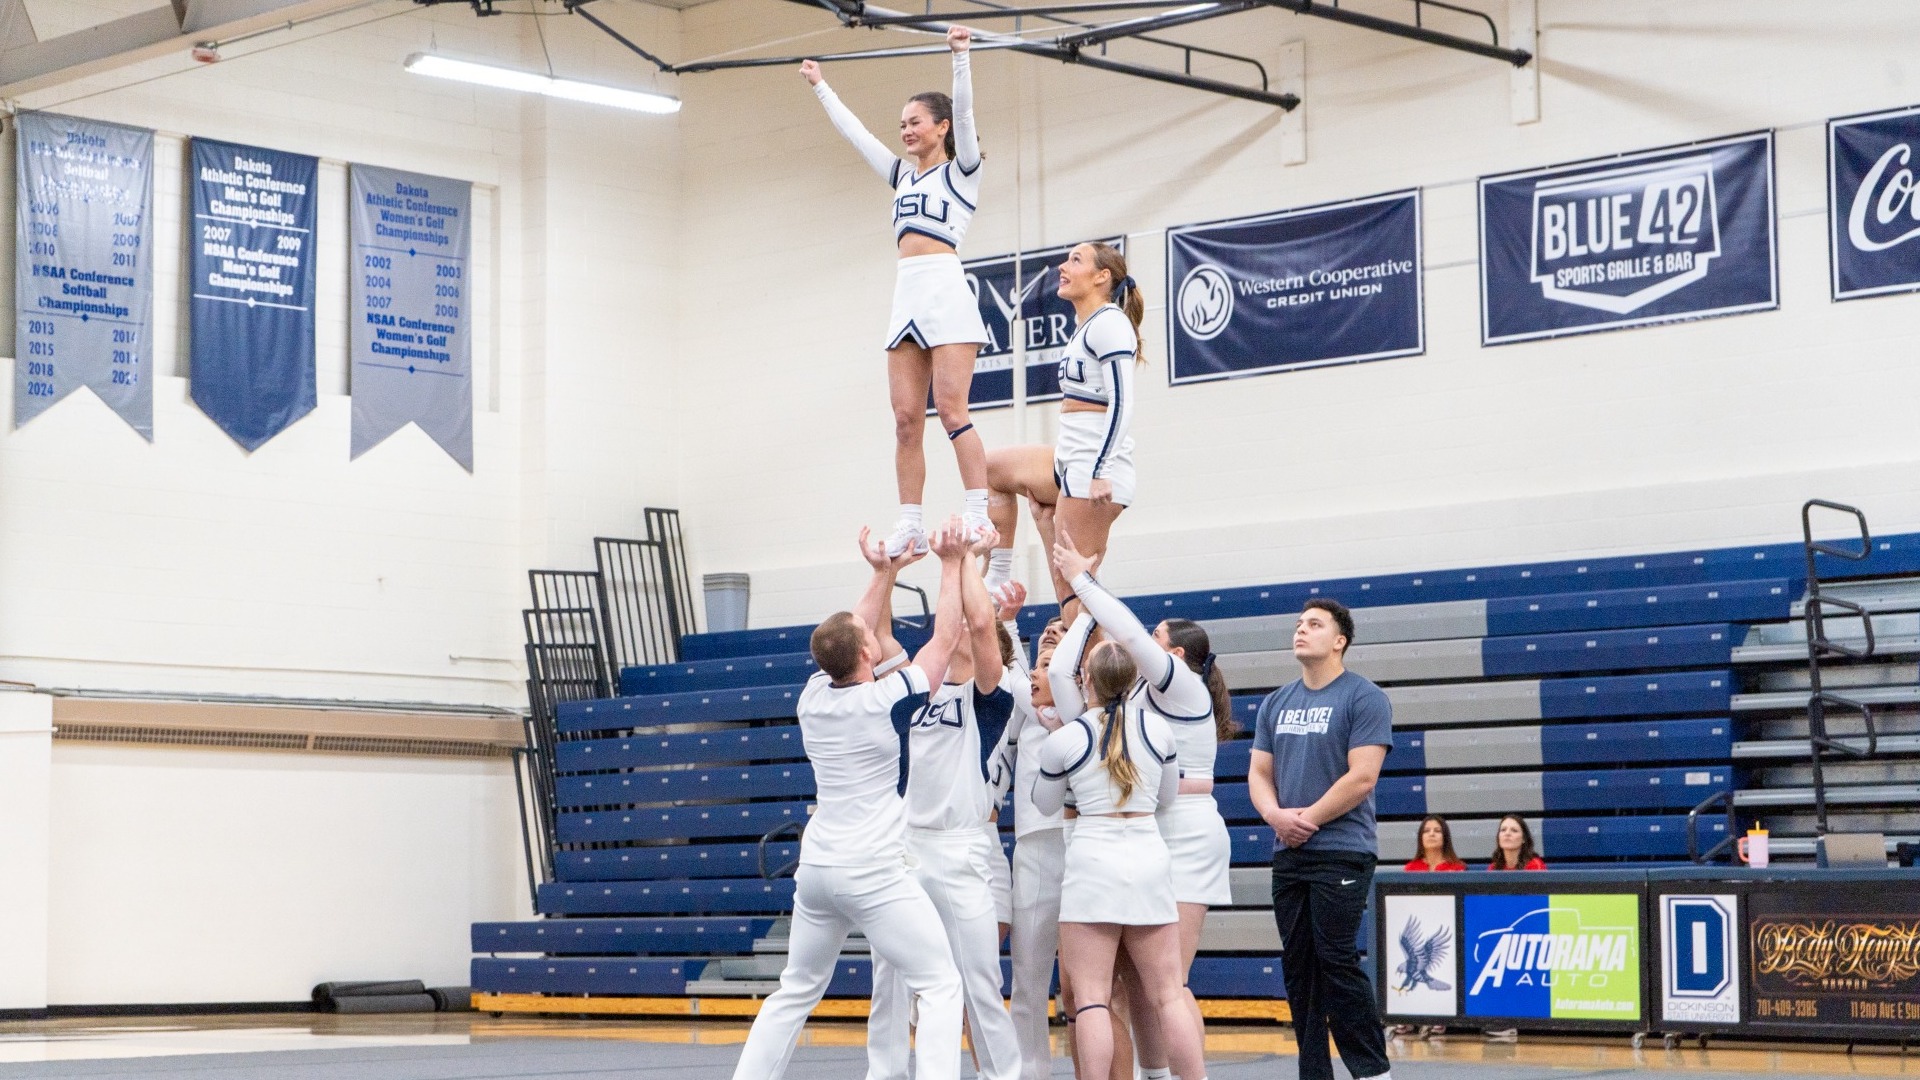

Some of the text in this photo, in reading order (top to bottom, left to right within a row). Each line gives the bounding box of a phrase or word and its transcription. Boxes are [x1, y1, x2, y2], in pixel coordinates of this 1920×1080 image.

[67, 132, 106, 148] Dakota
[235, 156, 272, 175] Dakota
[201, 166, 306, 195] Athletic Conference
[224, 186, 282, 207] Men's Golf
[396, 182, 429, 198] Dakota
[210, 199, 295, 225] Championships
[366, 192, 458, 217] Athletic Conference
[380, 209, 444, 230] Women's Golf
[1543, 181, 1702, 261] BLUE 42
[113, 233, 140, 248] 2009
[203, 224, 231, 241] 2007
[376, 223, 449, 246] Championships
[277, 235, 301, 251] 2009
[113, 252, 136, 268] 2011
[203, 242, 299, 268] NSAA Conference
[365, 255, 391, 270] 2002
[33, 264, 134, 287] NSAA Conference
[222, 260, 280, 279] Men's Golf
[436, 264, 461, 279] 2003
[1238, 258, 1413, 296] Western Cooperative
[1556, 251, 1693, 288] SPORTS GRILLE & BAR
[62, 282, 107, 299] Softball
[208, 272, 294, 297] Championships
[365, 275, 391, 289] 2004
[435, 284, 460, 298] 2006
[366, 295, 392, 309] 2007
[1266, 282, 1384, 309] CREDIT UNION
[38, 296, 129, 318] Championships
[435, 304, 459, 318] 2008
[29, 320, 55, 336] 2013
[366, 312, 455, 334] NSAA Conference
[376, 328, 447, 347] Women's Golf
[29, 341, 54, 356] 2015
[371, 342, 451, 363] Championships
[28, 361, 54, 377] 2018
[28, 381, 54, 396] 2024
[1277, 709, 1285, 724] I
[1669, 897, 1731, 998] D
[1469, 933, 1628, 996] AUTORAMA
[1516, 973, 1608, 987] AUTO
[1667, 1001, 1735, 1013] DICKINSON
[1667, 1011, 1735, 1021] STATE UNIVERSITY
